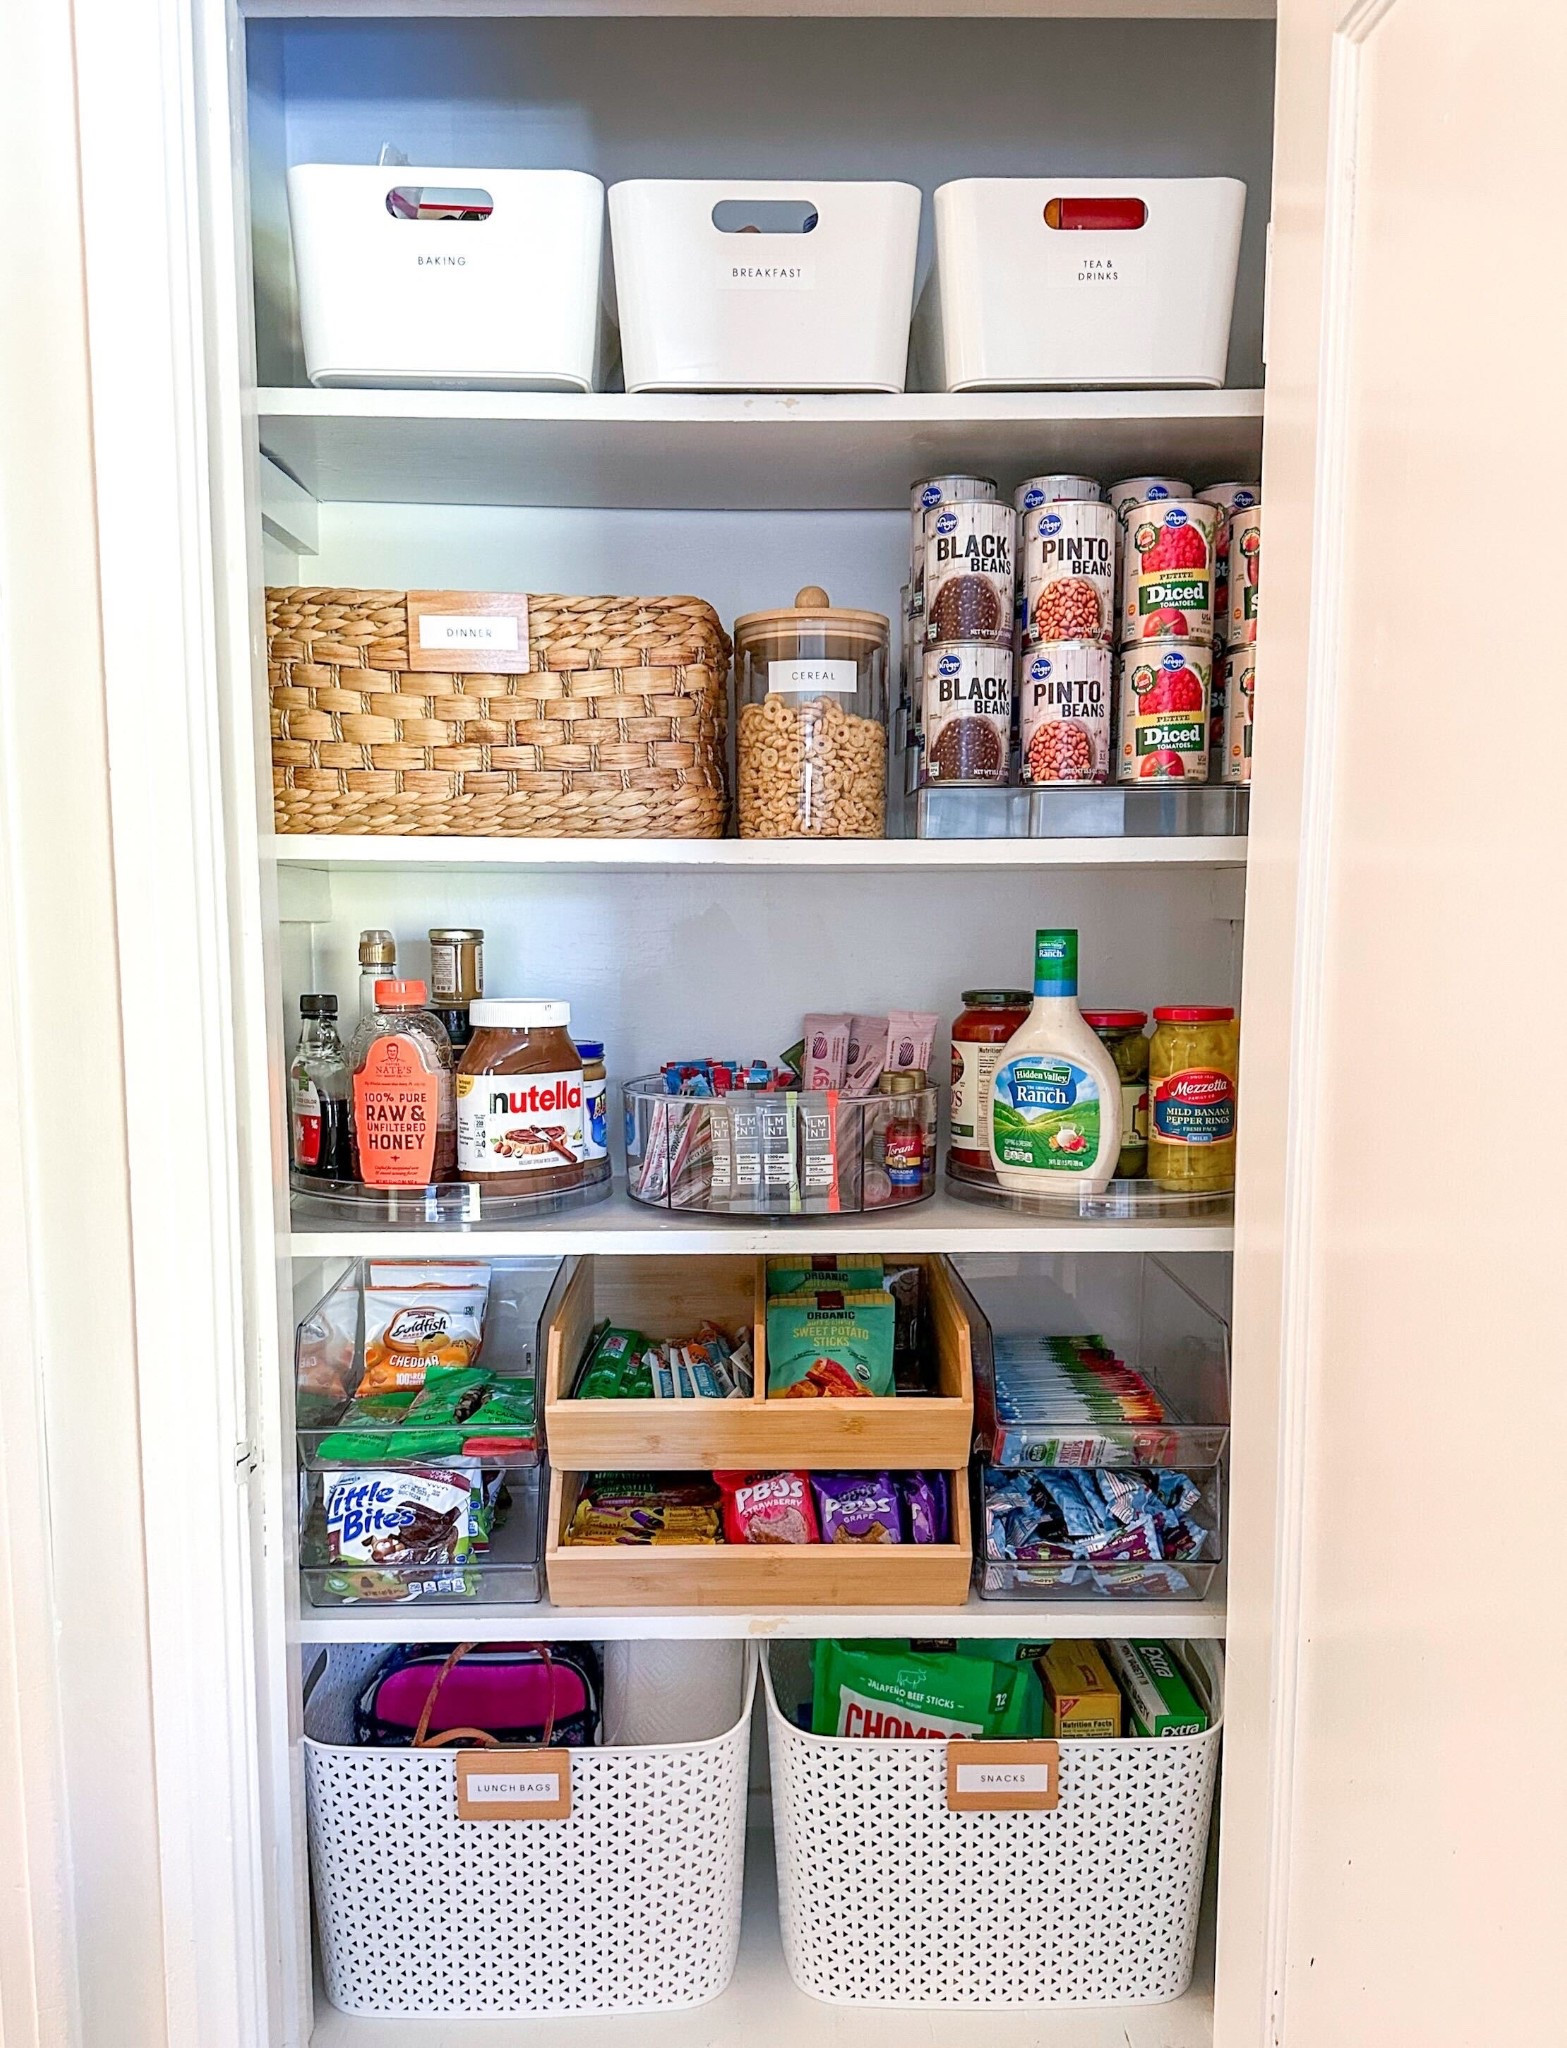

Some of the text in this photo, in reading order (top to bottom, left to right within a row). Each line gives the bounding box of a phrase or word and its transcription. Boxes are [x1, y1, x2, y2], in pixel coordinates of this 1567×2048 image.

[417, 256, 466, 266] BAKING
[1083, 260, 1113, 268] TEA &
[732, 267, 802, 278] BREAKFAST
[1077, 271, 1119, 281] DRINKS
[935, 517, 959, 531] Kroger
[1165, 511, 1187, 525] Kroger
[1038, 519, 1062, 533] Kroger
[937, 534, 1008, 561] BLACK
[1042, 537, 1109, 563] PINTO
[970, 557, 1011, 576] BEANS
[1071, 560, 1112, 578] BEANS
[1159, 571, 1194, 581] PETITE
[1146, 583, 1205, 604] Diced
[1159, 600, 1195, 608] TOMATOES
[446, 628, 492, 638] DINNER
[938, 659, 961, 672] Kroger
[1163, 655, 1185, 668] Kroger
[791, 671, 836, 680] CEREAL
[1030, 663, 1053, 677] Kroger
[939, 677, 1008, 702] BLACK
[1033, 680, 1101, 707] PINTO
[974, 700, 1010, 716] BEANS
[1062, 703, 1105, 718] BEANS
[1156, 714, 1191, 723] PETITE
[1144, 725, 1200, 746] Diced
[1039, 949, 1064, 958] Ranch
[375, 1066, 413, 1075] NATE'S
[1016, 1070, 1068, 1083] Hidden Valley
[1171, 1078, 1228, 1096] Mezzetta
[364, 1092, 427, 1103] 100% PURE
[489, 1080, 582, 1114] nutella
[1017, 1085, 1068, 1105] Ranch
[366, 1105, 426, 1121] RAW &
[1166, 1107, 1230, 1117] MILD BANANA
[714, 1120, 729, 1129] LM
[739, 1116, 756, 1126] LM
[767, 1116, 784, 1126] LM
[810, 1118, 826, 1128] LM
[1166, 1115, 1230, 1125] PEPPER RINGS
[367, 1122, 426, 1132] UNFILTERED
[714, 1129, 729, 1138] NT
[739, 1126, 756, 1135] NT
[767, 1126, 784, 1136] NT
[810, 1128, 826, 1138] NT
[368, 1133, 426, 1150] HONEY
[887, 1142, 915, 1157] Torani
[804, 1271, 849, 1282] ORGANIC
[806, 1311, 856, 1320] ORGANIC
[391, 1317, 447, 1337] Goldfish
[792, 1326, 869, 1340] SWEET POTATO
[813, 1336, 850, 1347] STICKS
[389, 1354, 440, 1368] CHEDDAR
[327, 1480, 394, 1525] Little
[734, 1478, 803, 1514] PB&JS
[742, 1499, 803, 1518] STRAWBERRY
[825, 1498, 891, 1522] PB&JS
[843, 1513, 875, 1523] GRAPE
[343, 1508, 416, 1543] Bites
[1139, 1646, 1174, 1678] Extra
[867, 1677, 955, 1709] JALAPEÑO BEEF STICKS
[995, 1693, 1008, 1706] 12
[845, 1703, 970, 1738] CHO
[1062, 1720, 1112, 1728] Nutrition Facts
[1161, 1723, 1200, 1738] Extra
[980, 1774, 1026, 1783] SNACKS
[477, 1783, 551, 1792] LUNCH BAGS
